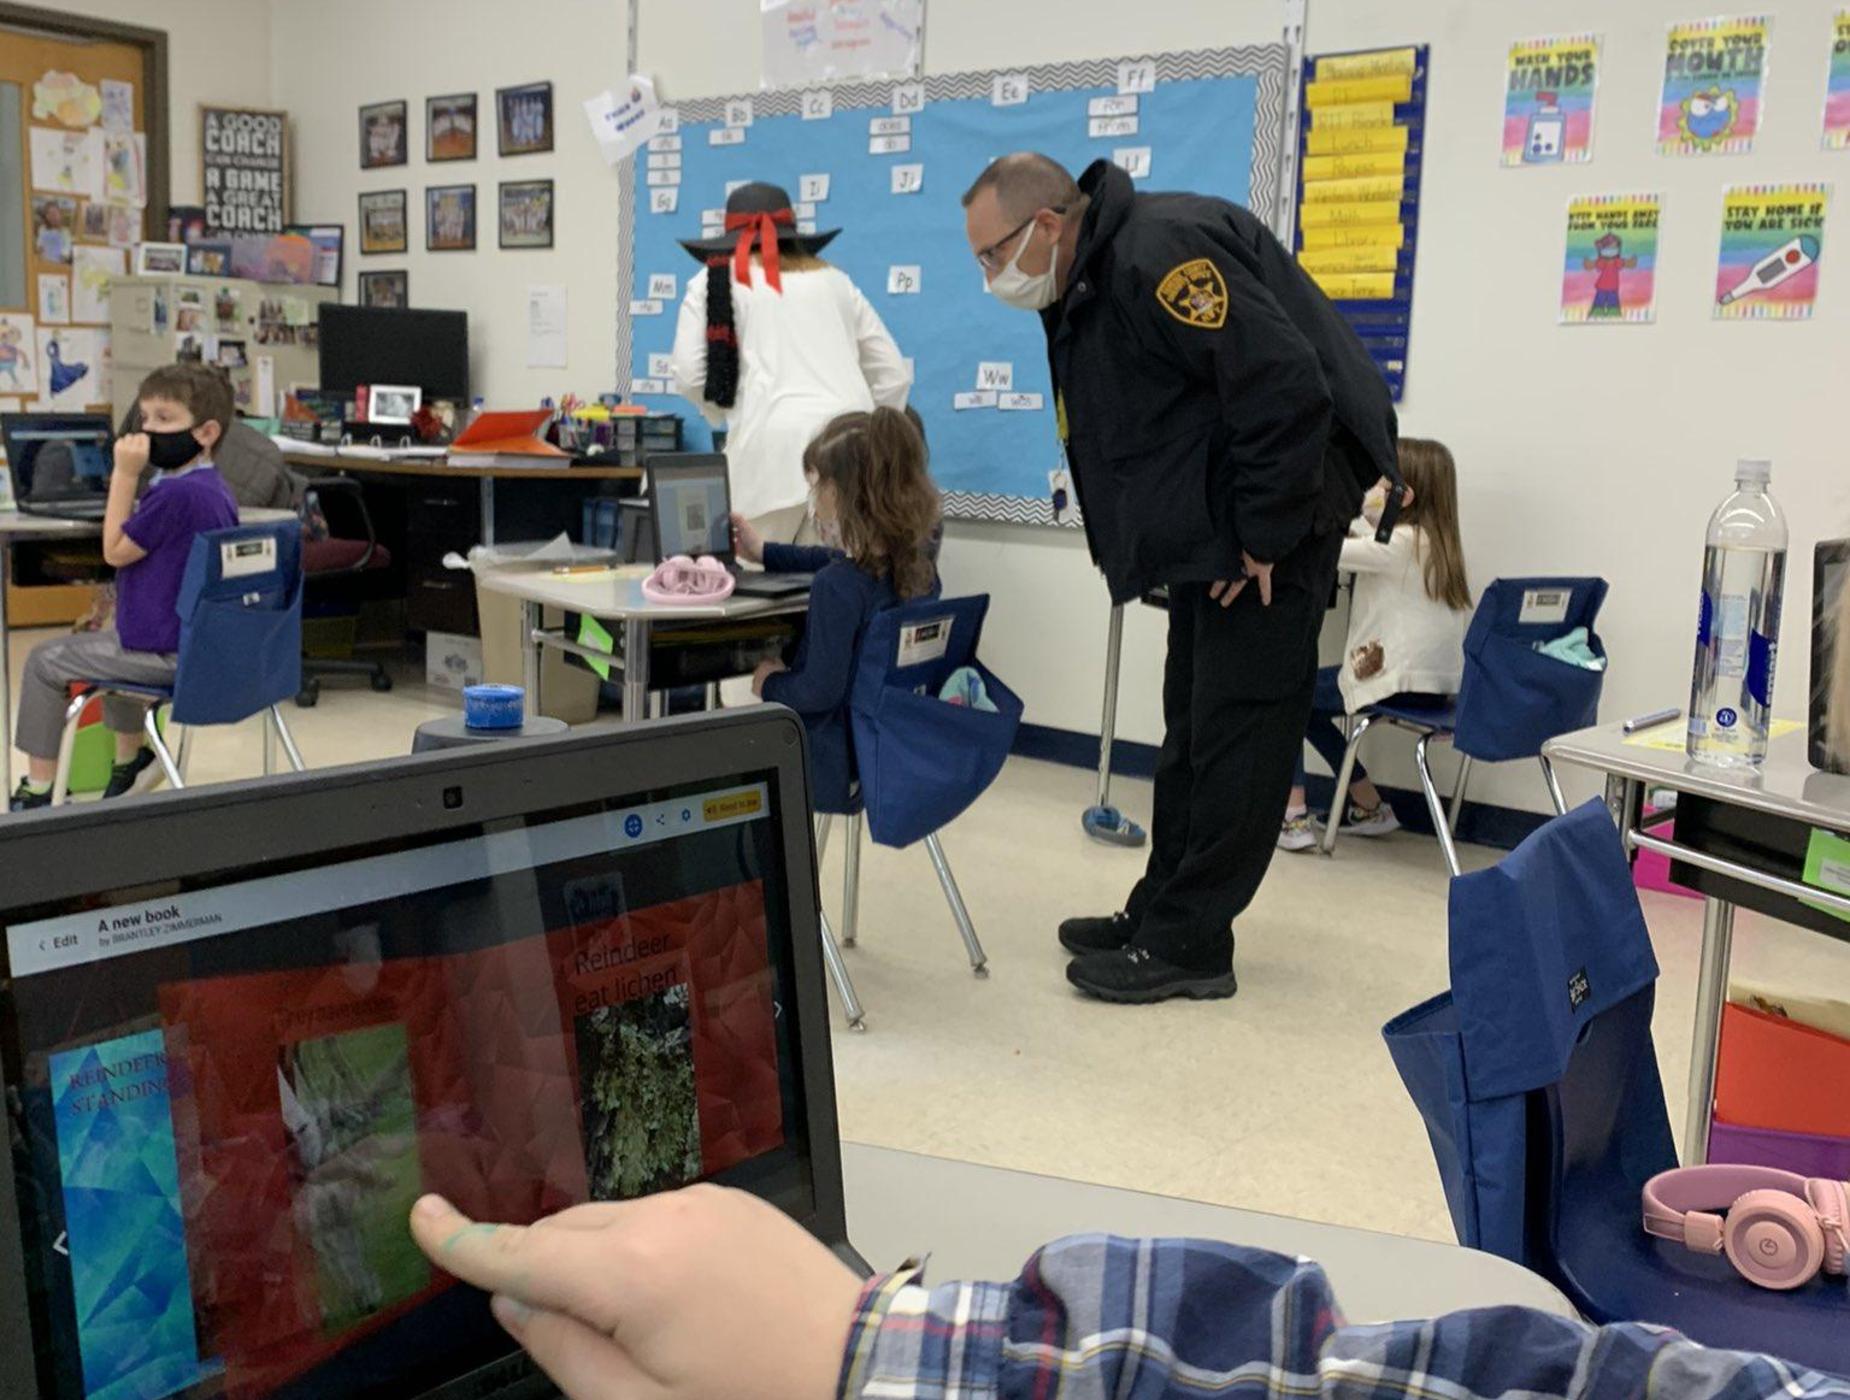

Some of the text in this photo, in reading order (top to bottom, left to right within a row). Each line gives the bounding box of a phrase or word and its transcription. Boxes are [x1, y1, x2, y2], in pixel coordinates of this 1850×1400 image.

[1667, 47, 1764, 72] MOUTH
[1510, 63, 1594, 89] HANDS
[898, 92, 919, 108] Dd
[1001, 81, 1019, 101] Ee
[808, 101, 827, 116] Cc
[207, 112, 281, 131] A GOOD
[206, 129, 280, 155] COACH
[206, 167, 281, 191] A GAME
[207, 190, 281, 208] A GREAT
[206, 205, 282, 230] COACH
[1727, 205, 1759, 218] STAY
[1765, 203, 1804, 216] HOME
[1725, 216, 1825, 231] YOU ARE SICK
[896, 271, 914, 291] Pp
[983, 368, 1010, 385] Ww
[98, 905, 180, 933] A new book
[98, 937, 110, 948] by
[164, 913, 222, 935] ZIMMERMAN
[53, 934, 78, 949] Edit
[574, 932, 671, 976] Reindeer
[574, 963, 678, 1014] eat lichen
